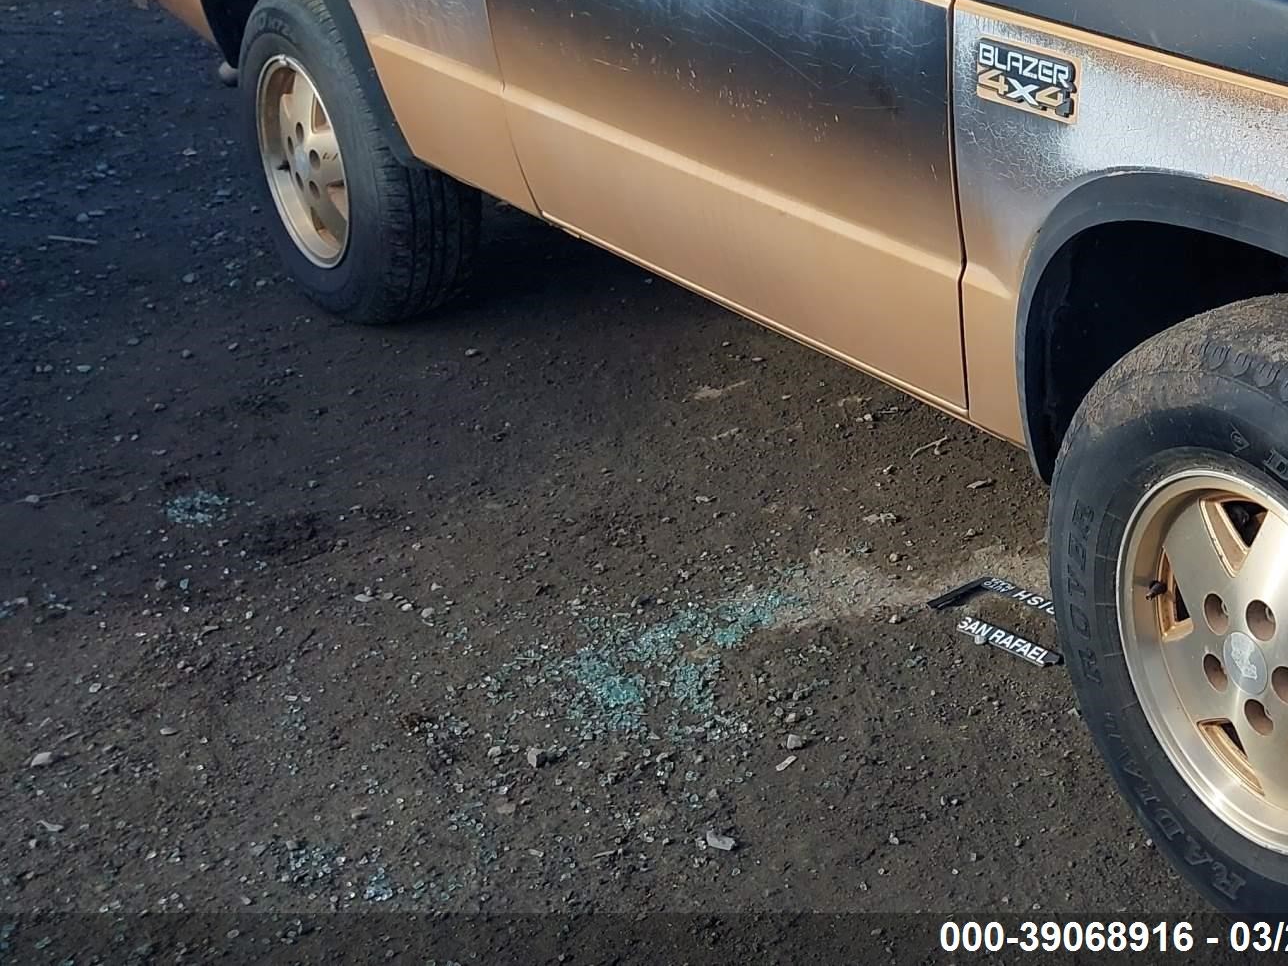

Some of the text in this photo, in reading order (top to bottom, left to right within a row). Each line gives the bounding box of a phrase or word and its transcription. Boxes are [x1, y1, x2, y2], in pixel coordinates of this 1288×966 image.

[979, 43, 1069, 88] BLAZER
[957, 616, 1050, 666] SAN RAFAEL
